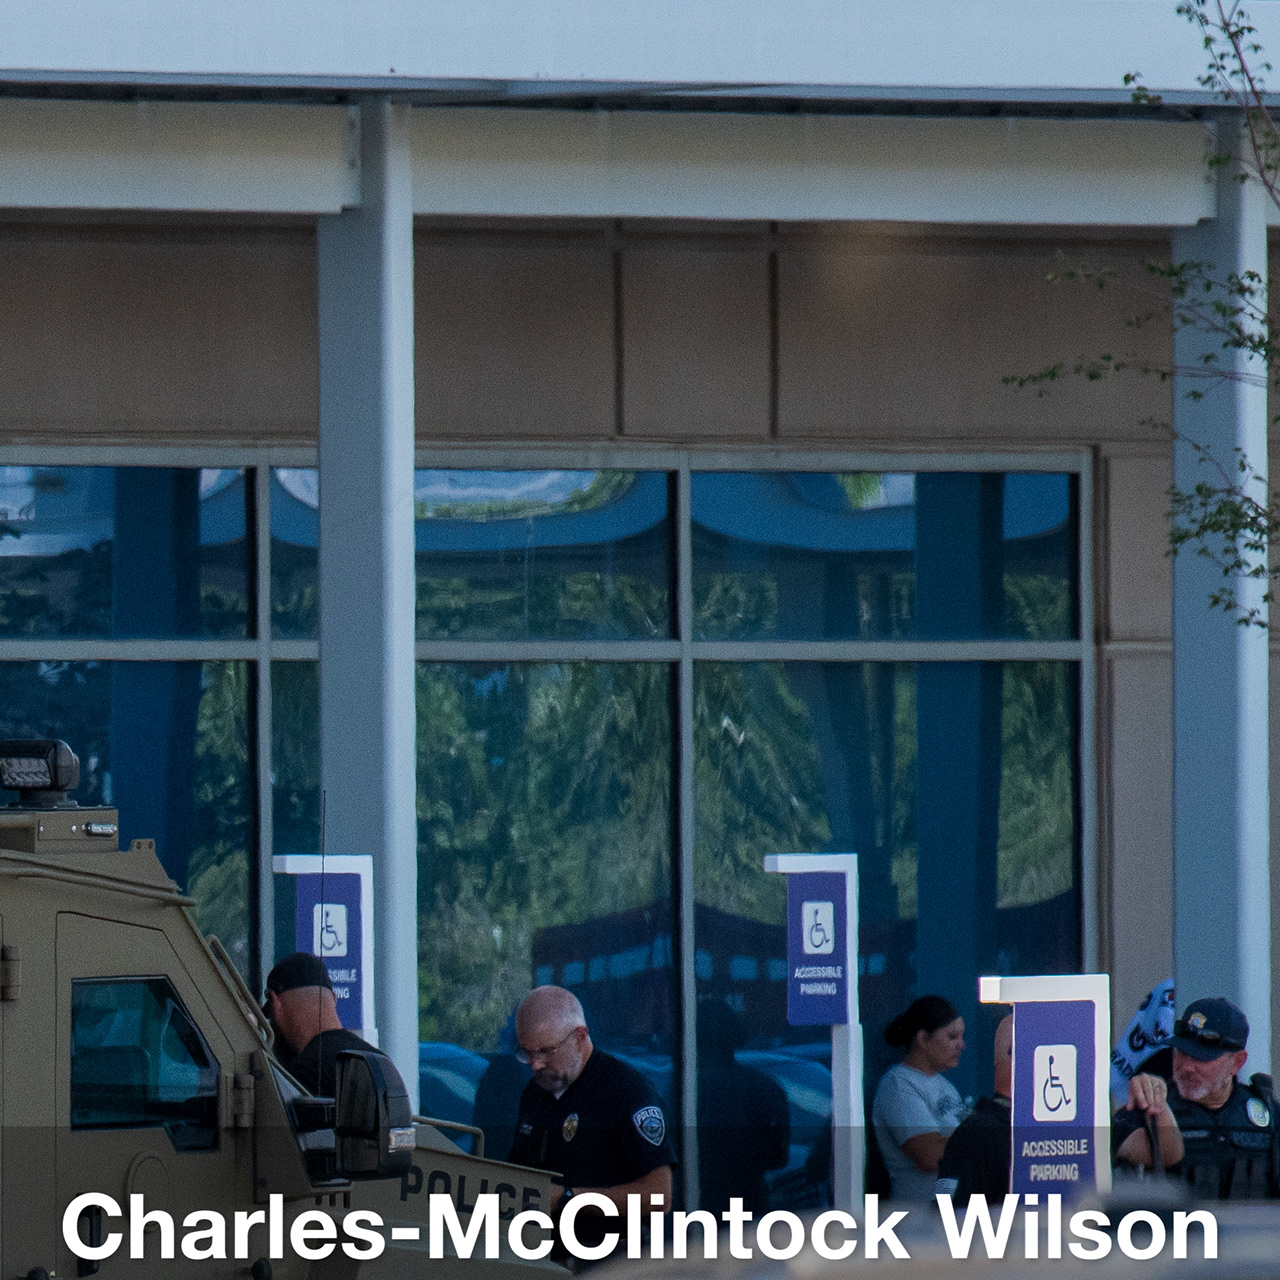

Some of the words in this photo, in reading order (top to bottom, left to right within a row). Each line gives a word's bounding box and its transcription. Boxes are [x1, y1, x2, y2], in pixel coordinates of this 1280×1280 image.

[328, 968, 357, 983] SSIBLE
[1022, 1138, 1089, 1158] ACCESSIBLE
[1030, 1164, 1079, 1181] PARKING
